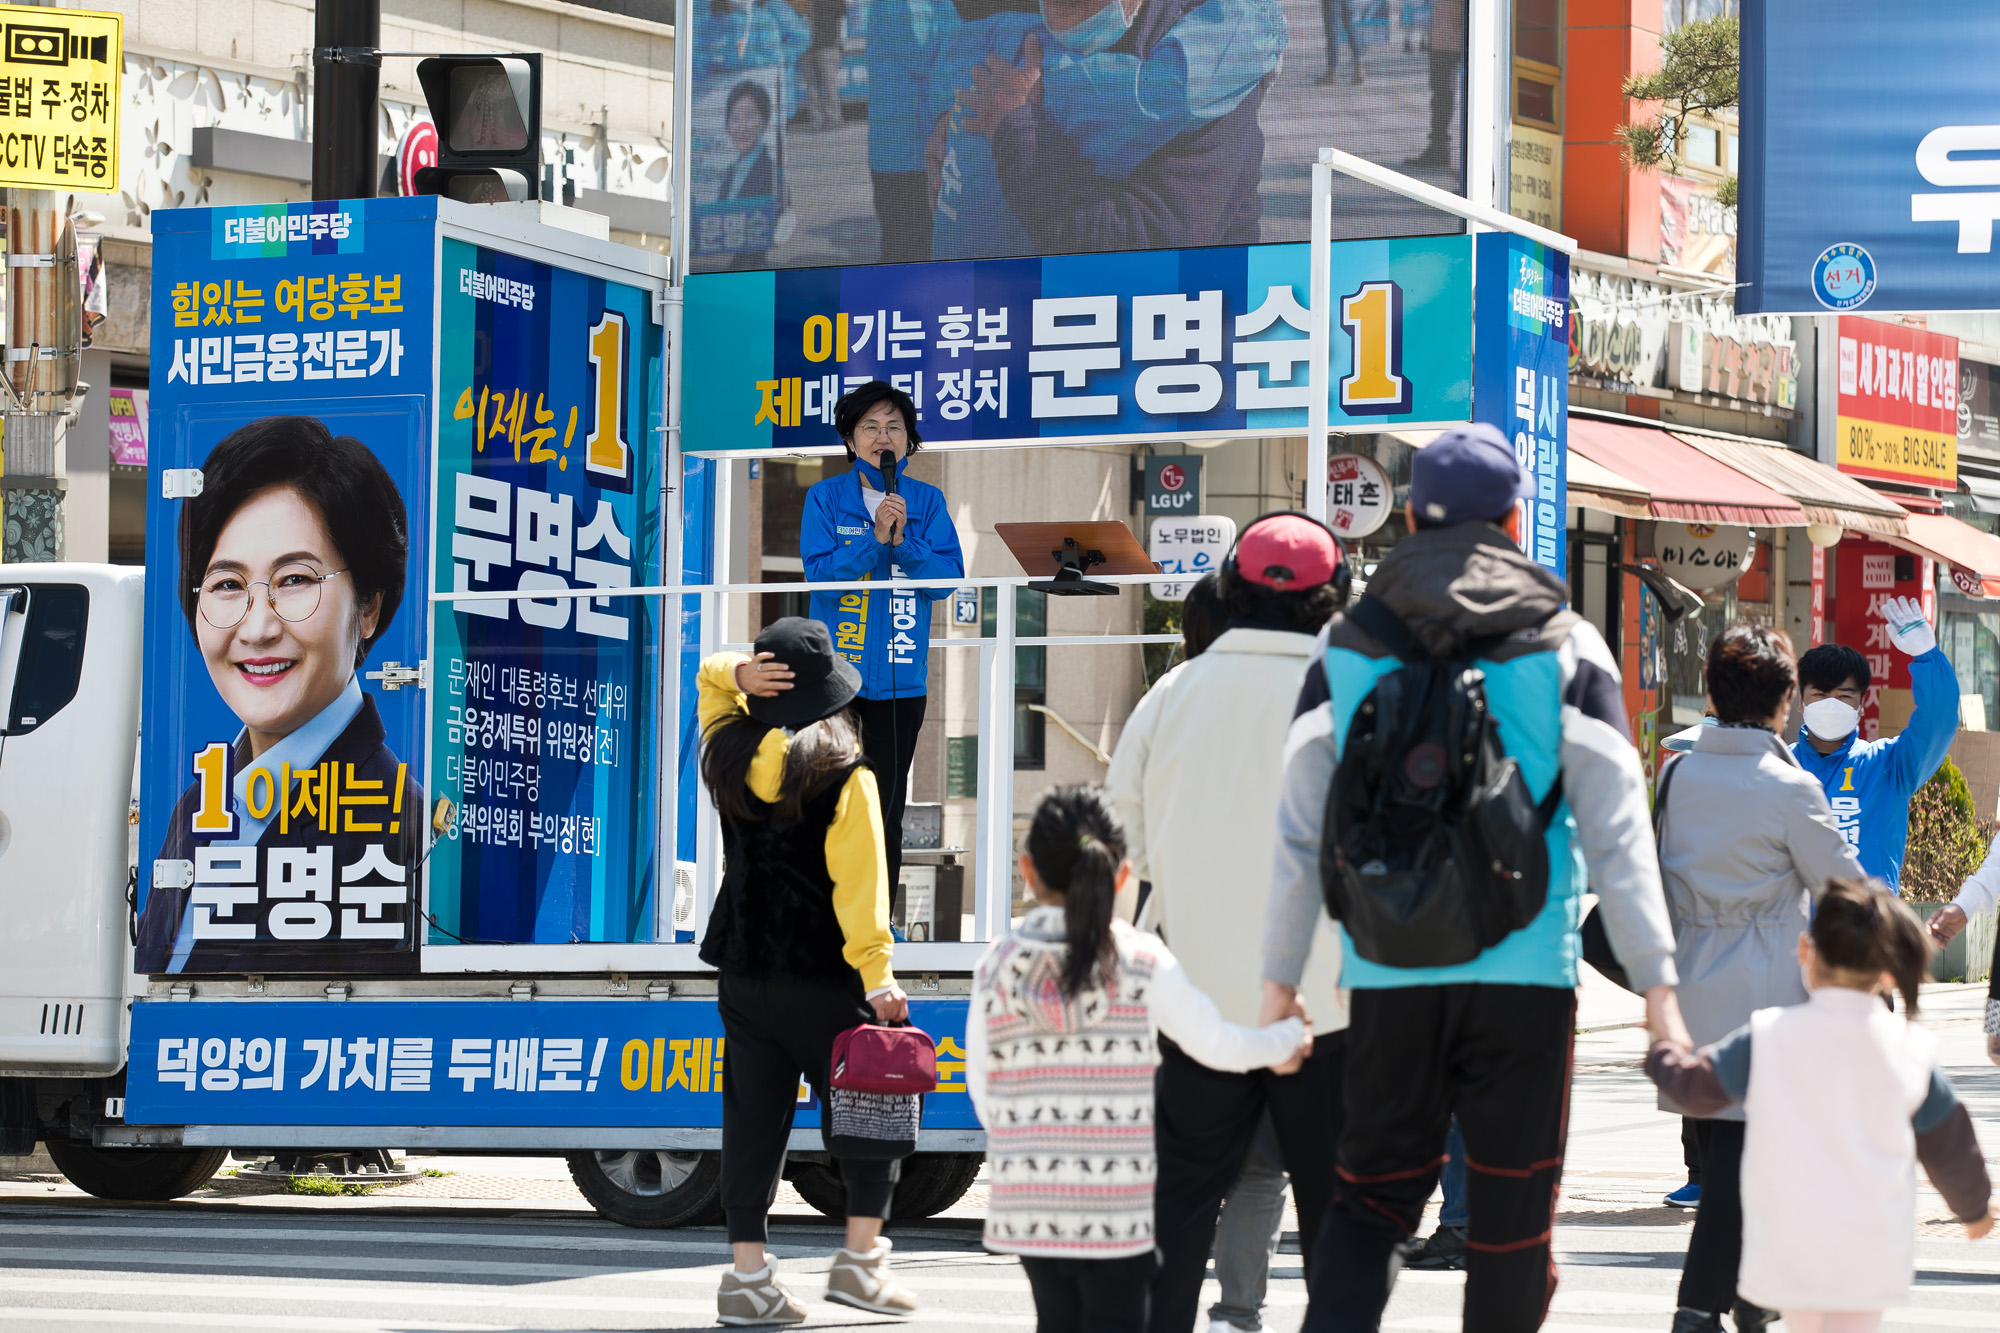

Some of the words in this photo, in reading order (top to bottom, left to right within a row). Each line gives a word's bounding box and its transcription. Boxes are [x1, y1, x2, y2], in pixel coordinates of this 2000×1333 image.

[0, 132, 46, 170] CTV
[54, 134, 108, 178] 단속중
[224, 212, 353, 245] 더불어민주당
[170, 281, 263, 328] 힘있는
[274, 273, 404, 322] 여당후보
[460, 268, 536, 311] 더불어민주당
[1825, 267, 1860, 290] 선거
[803, 310, 926, 363] 이기는
[936, 306, 1012, 358] 후보
[1513, 287, 1565, 329] 더불어민주당
[167, 328, 404, 386] 서민금융전문가
[1029, 285, 1311, 419] 문명순
[1340, 280, 1412, 415] 1
[586, 309, 632, 493] 1
[755, 374, 874, 428] 제대
[936, 367, 1009, 421] 정치
[453, 385, 578, 472] 이제는!
[1904, 436, 1920, 467] BIG
[1923, 438, 1947, 470] SALE
[1327, 482, 1380, 507] 태촌
[452, 472, 632, 641] 문명순
[1159, 528, 1221, 544] 노무법인
[836, 570, 872, 651] 의원
[958, 601, 976, 622] 30
[1163, 584, 1182, 597] 2F
[448, 658, 496, 700] 문재인
[501, 667, 578, 711] 대통령후보
[583, 680, 628, 721] 선대위
[446, 705, 542, 756] 금융경제특위
[546, 721, 619, 767] 위원장[전]
[191, 741, 240, 840] 1
[246, 760, 408, 834] 이제는!
[446, 754, 542, 802] 더불어민주당
[1839, 767, 1855, 791] 1
[528, 812, 601, 857] 부의장[현]
[191, 844, 408, 940] 문명순
[157, 1037, 287, 1092] 덕양의
[300, 1037, 434, 1092] 가치를
[448, 1037, 610, 1093] 두배로!
